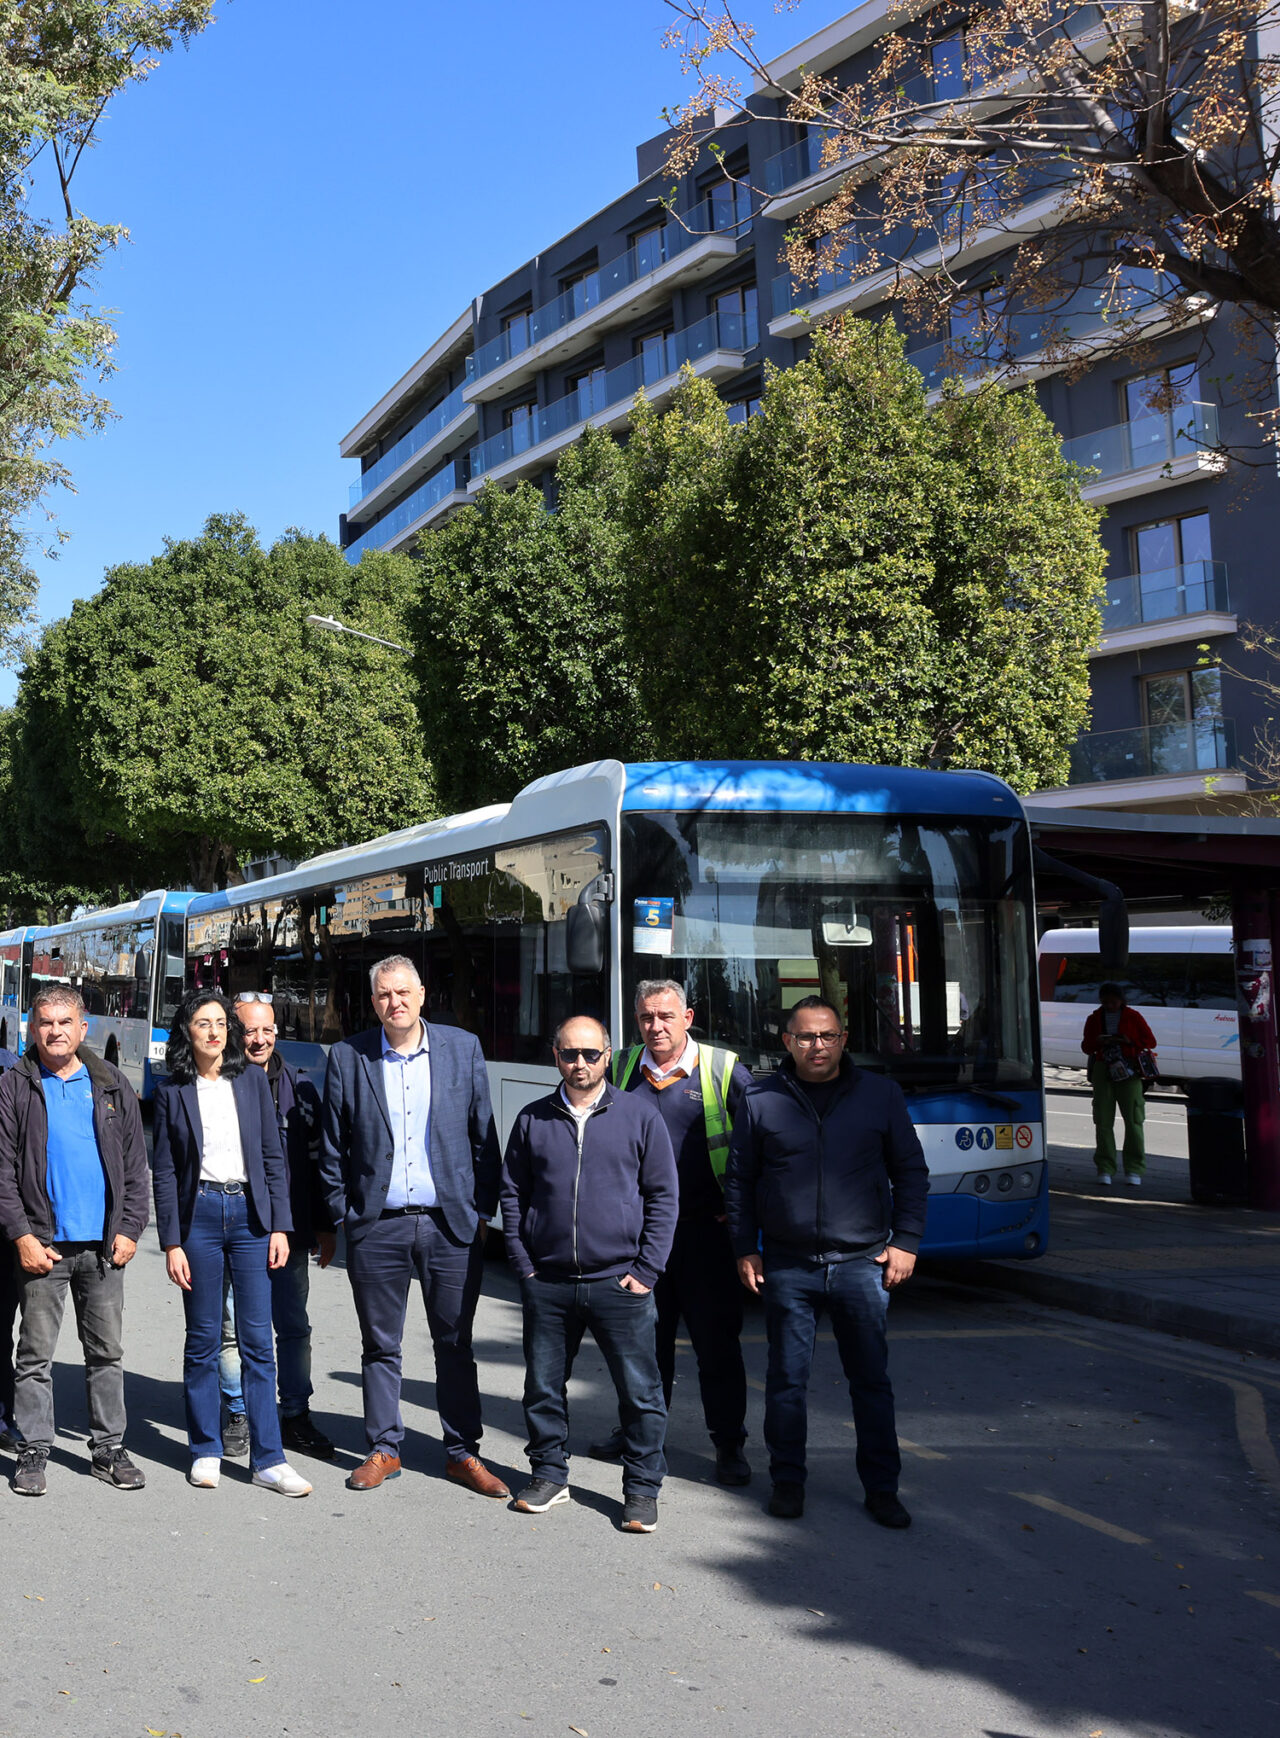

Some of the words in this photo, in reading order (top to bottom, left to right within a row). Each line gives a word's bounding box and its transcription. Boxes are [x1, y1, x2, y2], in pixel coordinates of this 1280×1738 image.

[424, 863, 448, 884] Public
[448, 858, 490, 881] Transport
[645, 909, 660, 926] 5
